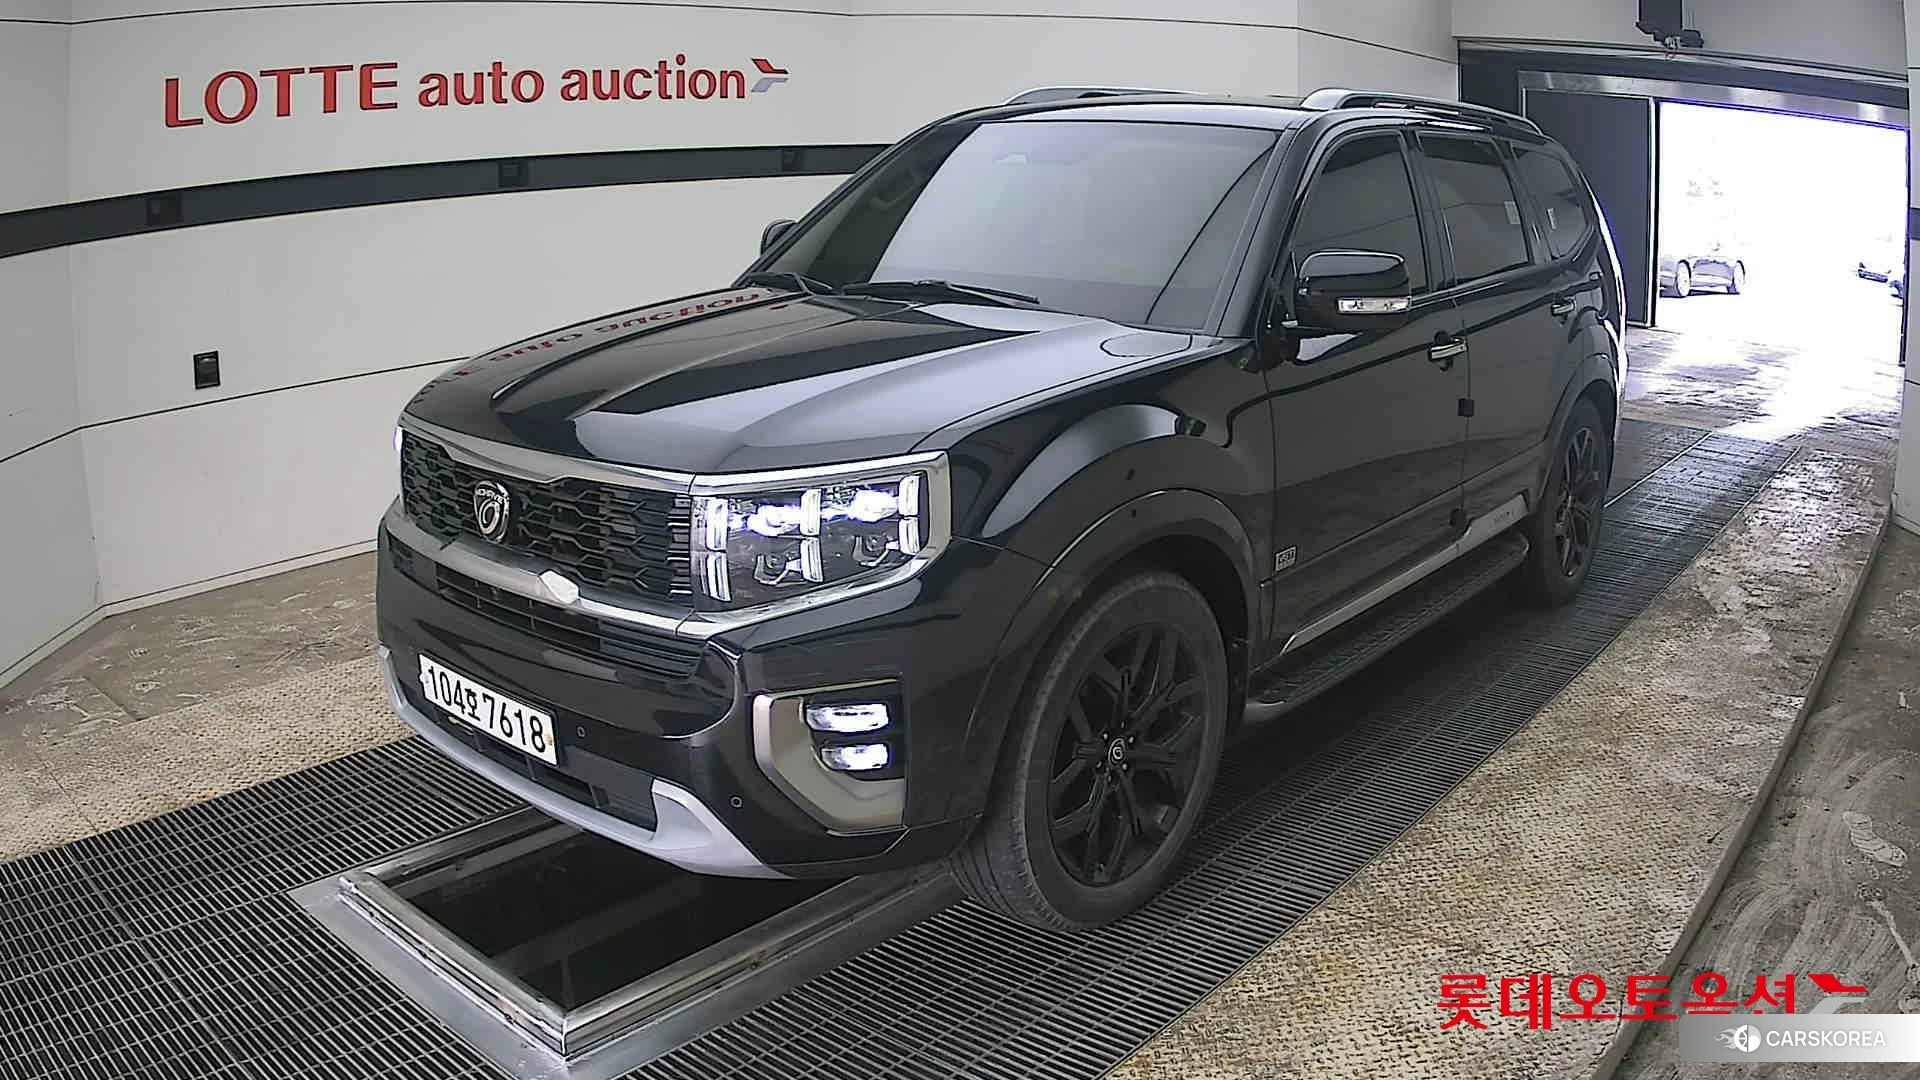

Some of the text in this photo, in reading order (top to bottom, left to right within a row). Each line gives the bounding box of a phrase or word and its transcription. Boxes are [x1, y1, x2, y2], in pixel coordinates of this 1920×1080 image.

[163, 54, 746, 128] LOTTE auto auction
